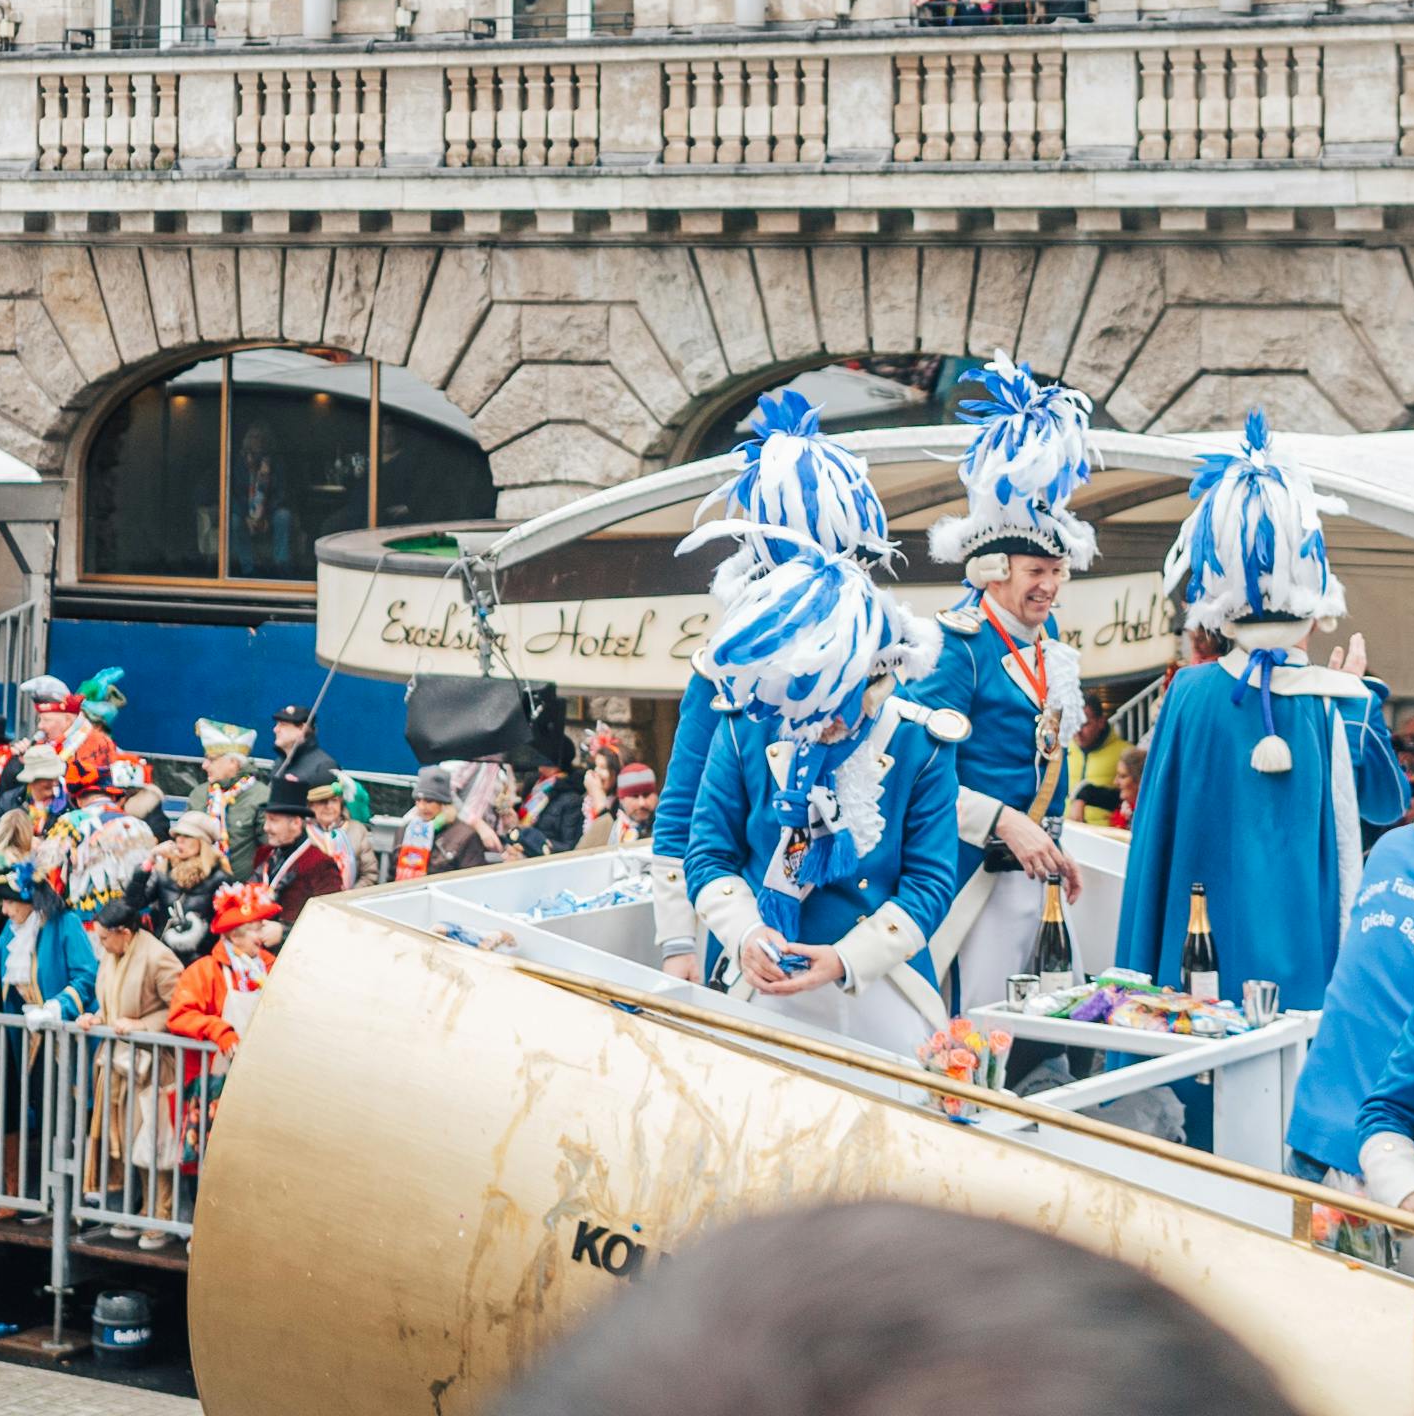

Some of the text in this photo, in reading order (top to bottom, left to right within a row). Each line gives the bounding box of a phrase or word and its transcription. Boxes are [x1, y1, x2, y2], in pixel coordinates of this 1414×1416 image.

[380, 598, 507, 652] Excelsir
[525, 600, 656, 658] Hotel
[1094, 586, 1156, 646] Hotel
